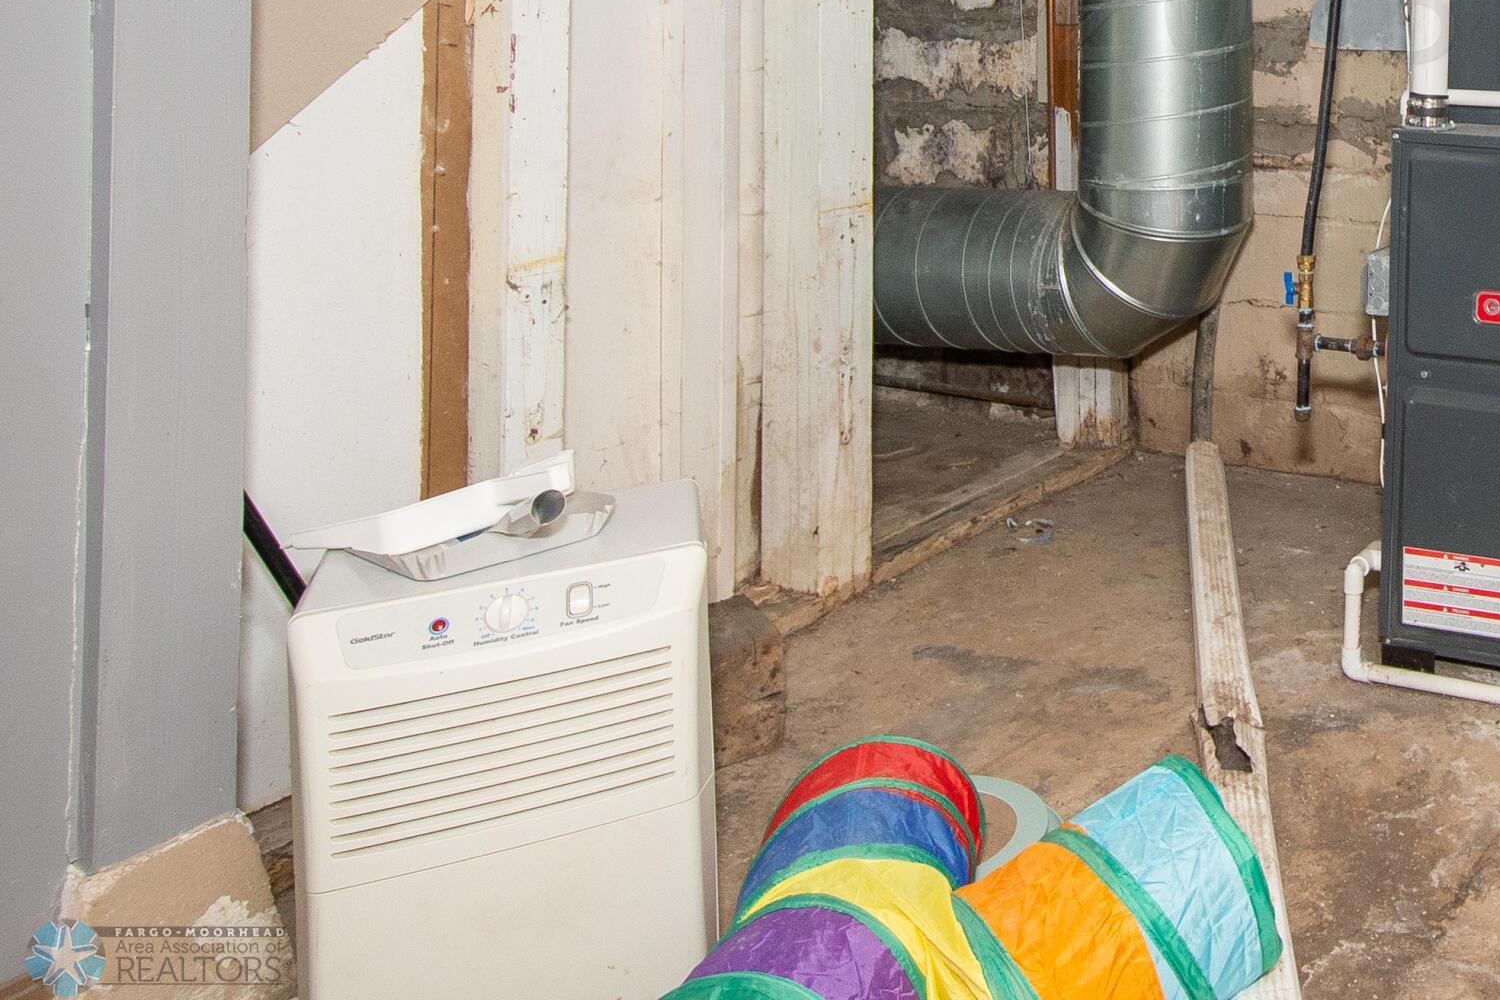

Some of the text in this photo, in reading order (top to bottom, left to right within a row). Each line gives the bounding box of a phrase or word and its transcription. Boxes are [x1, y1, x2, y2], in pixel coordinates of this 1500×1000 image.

[350, 631, 396, 645] GoldStar
[429, 633, 448, 642] Auto
[473, 628, 540, 646] Humidity Control
[421, 639, 455, 650] Shut-Off
